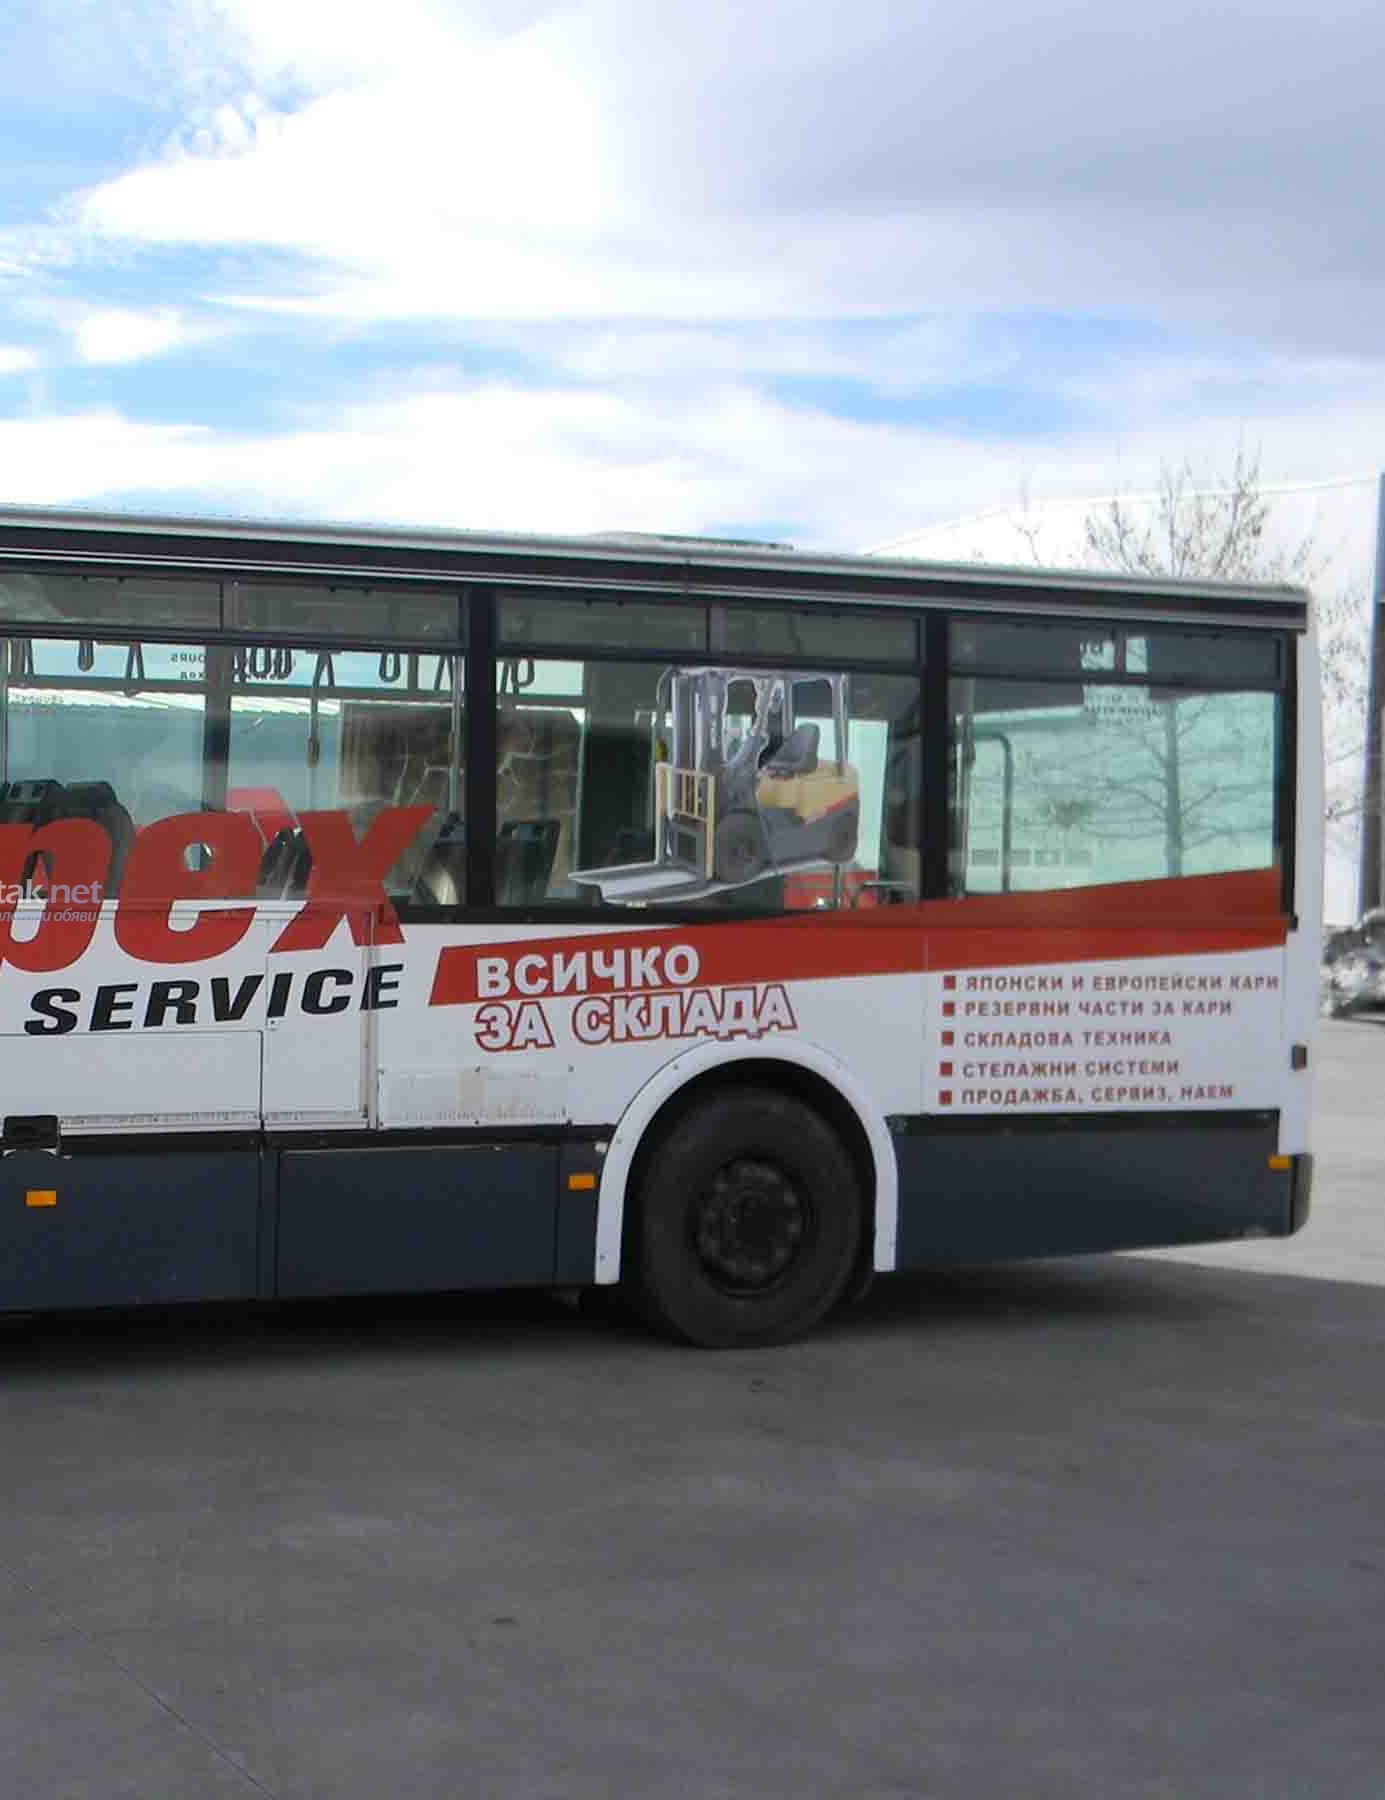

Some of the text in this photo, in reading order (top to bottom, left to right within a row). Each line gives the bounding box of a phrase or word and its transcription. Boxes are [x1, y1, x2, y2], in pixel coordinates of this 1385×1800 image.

[476, 944, 700, 999] ВСИЧКО
[965, 972, 1280, 992] ЯПОНСКИ И ЕВРОПЕЙСКИ КАРИ
[23, 963, 405, 1036] SERVICE
[964, 1000, 1233, 1017] РЕЗЕРВНИ ЧАСТИ ЗА КАРИ
[474, 983, 799, 1052] ЗА СКЛАДА
[963, 1030, 1172, 1051] СКЛАДОВА ТЕХНИКА
[962, 1059, 1180, 1079] СТЕЛАЖНИ СИСТЕМИ
[961, 1085, 1234, 1107] ПРОДАЖБА, СЕРВИЗ, НАЕМ
